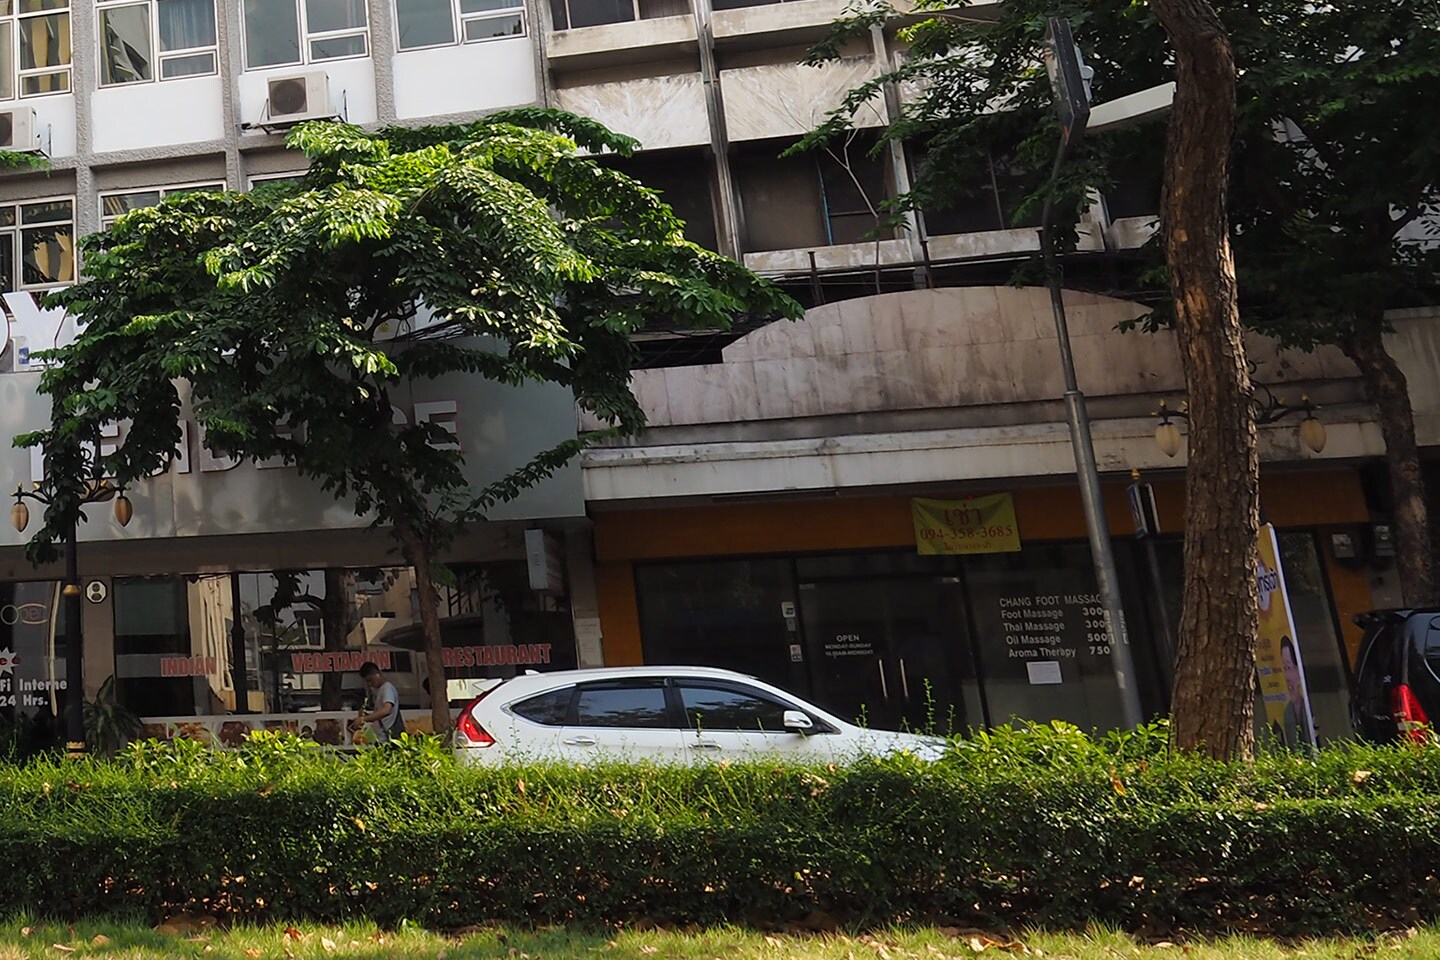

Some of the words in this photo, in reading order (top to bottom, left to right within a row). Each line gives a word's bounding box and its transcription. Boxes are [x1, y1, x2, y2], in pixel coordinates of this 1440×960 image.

[920, 524, 1013, 540] 094-358-3685
[1000, 597, 1031, 607] CHANG
[1036, 595, 1060, 606] FOOT
[1064, 594, 1102, 605] MASSAG
[1001, 609, 1021, 619] Foot
[1023, 608, 1064, 619] Massage
[1082, 607, 1103, 616] 300
[1003, 622, 1023, 632] Thai
[1025, 621, 1065, 632] Massage
[1085, 620, 1106, 629] 300
[1005, 635, 1019, 645] Oil
[1021, 634, 1062, 645] Massage
[1087, 633, 1108, 642] 500
[1008, 649, 1038, 658] Aroma
[1040, 647, 1076, 658] Therapy
[1089, 646, 1111, 655] 750
[161, 656, 217, 677] INDIAN
[291, 650, 391, 673] VEGETARIAN
[442, 644, 552, 668] RESTAURANT
[22, 694, 49, 707] Hrs.
